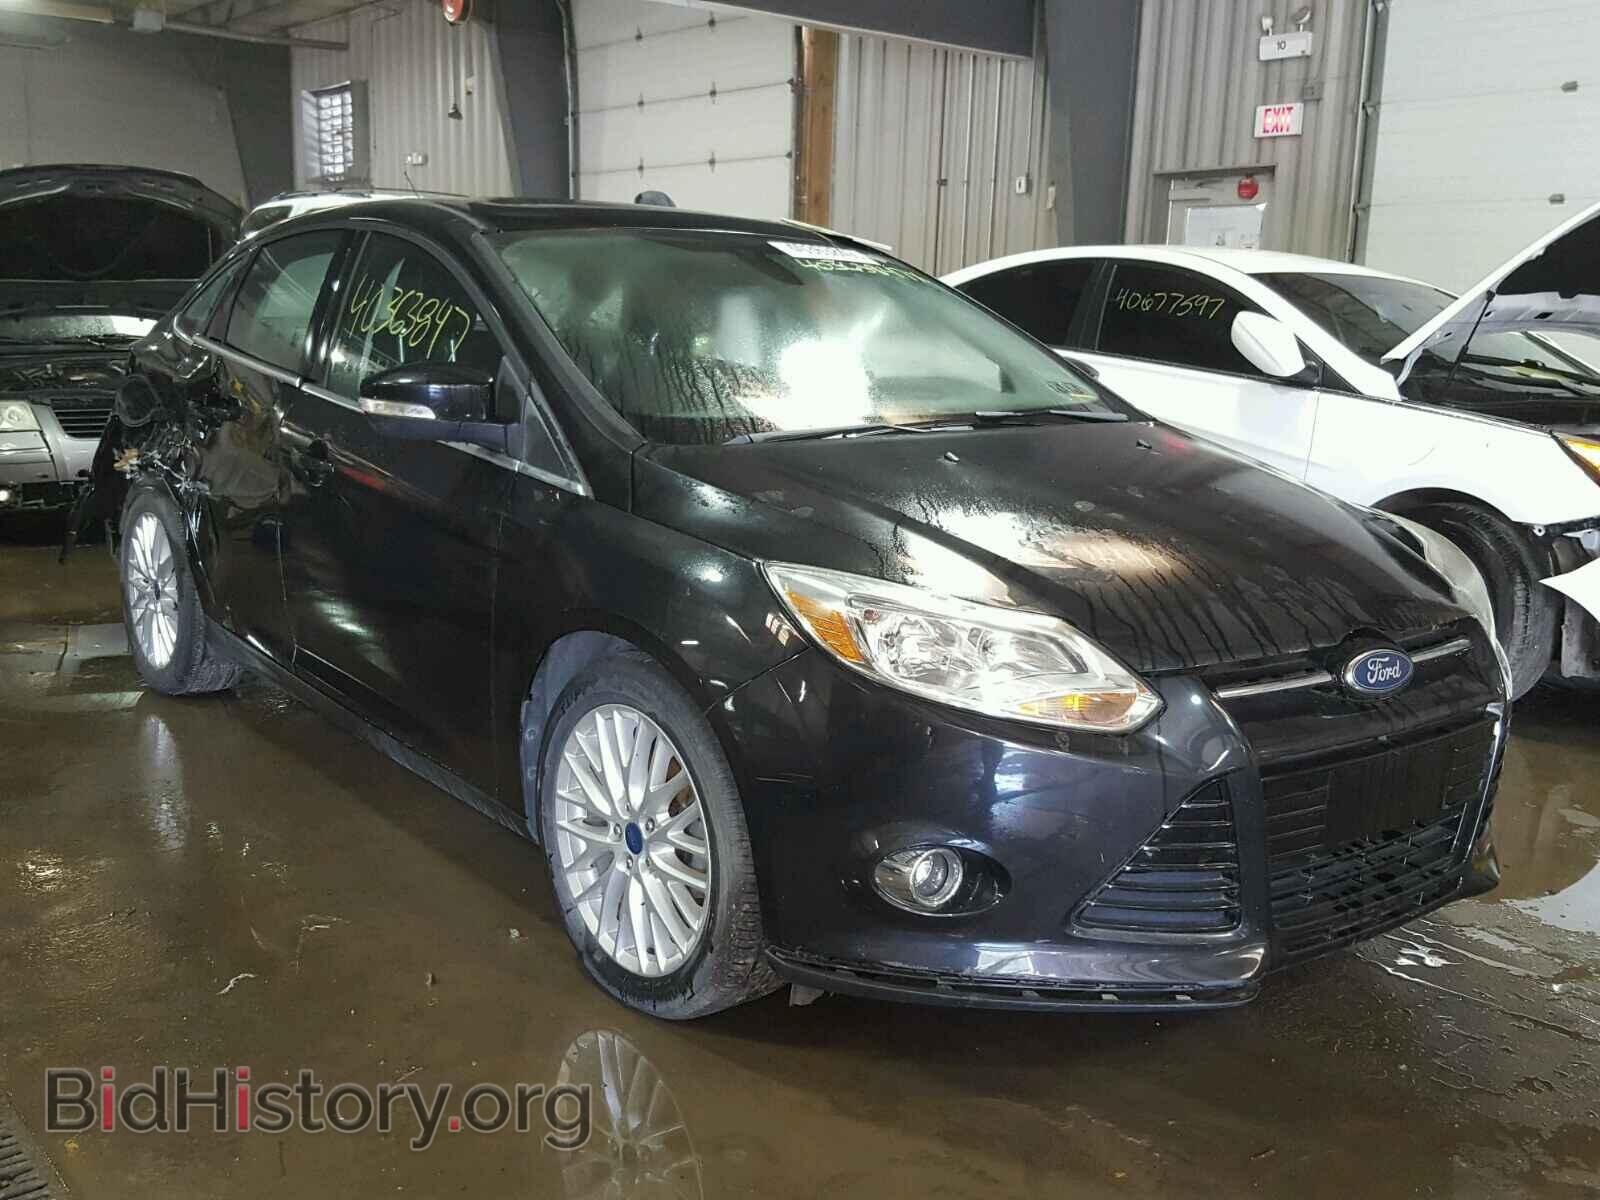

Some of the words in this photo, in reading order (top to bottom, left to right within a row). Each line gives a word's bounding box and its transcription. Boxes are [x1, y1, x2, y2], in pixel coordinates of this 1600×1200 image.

[1263, 106, 1294, 134] EXIT
[1116, 288, 1225, 319] 40677597
[1367, 656, 1401, 684] Ford
